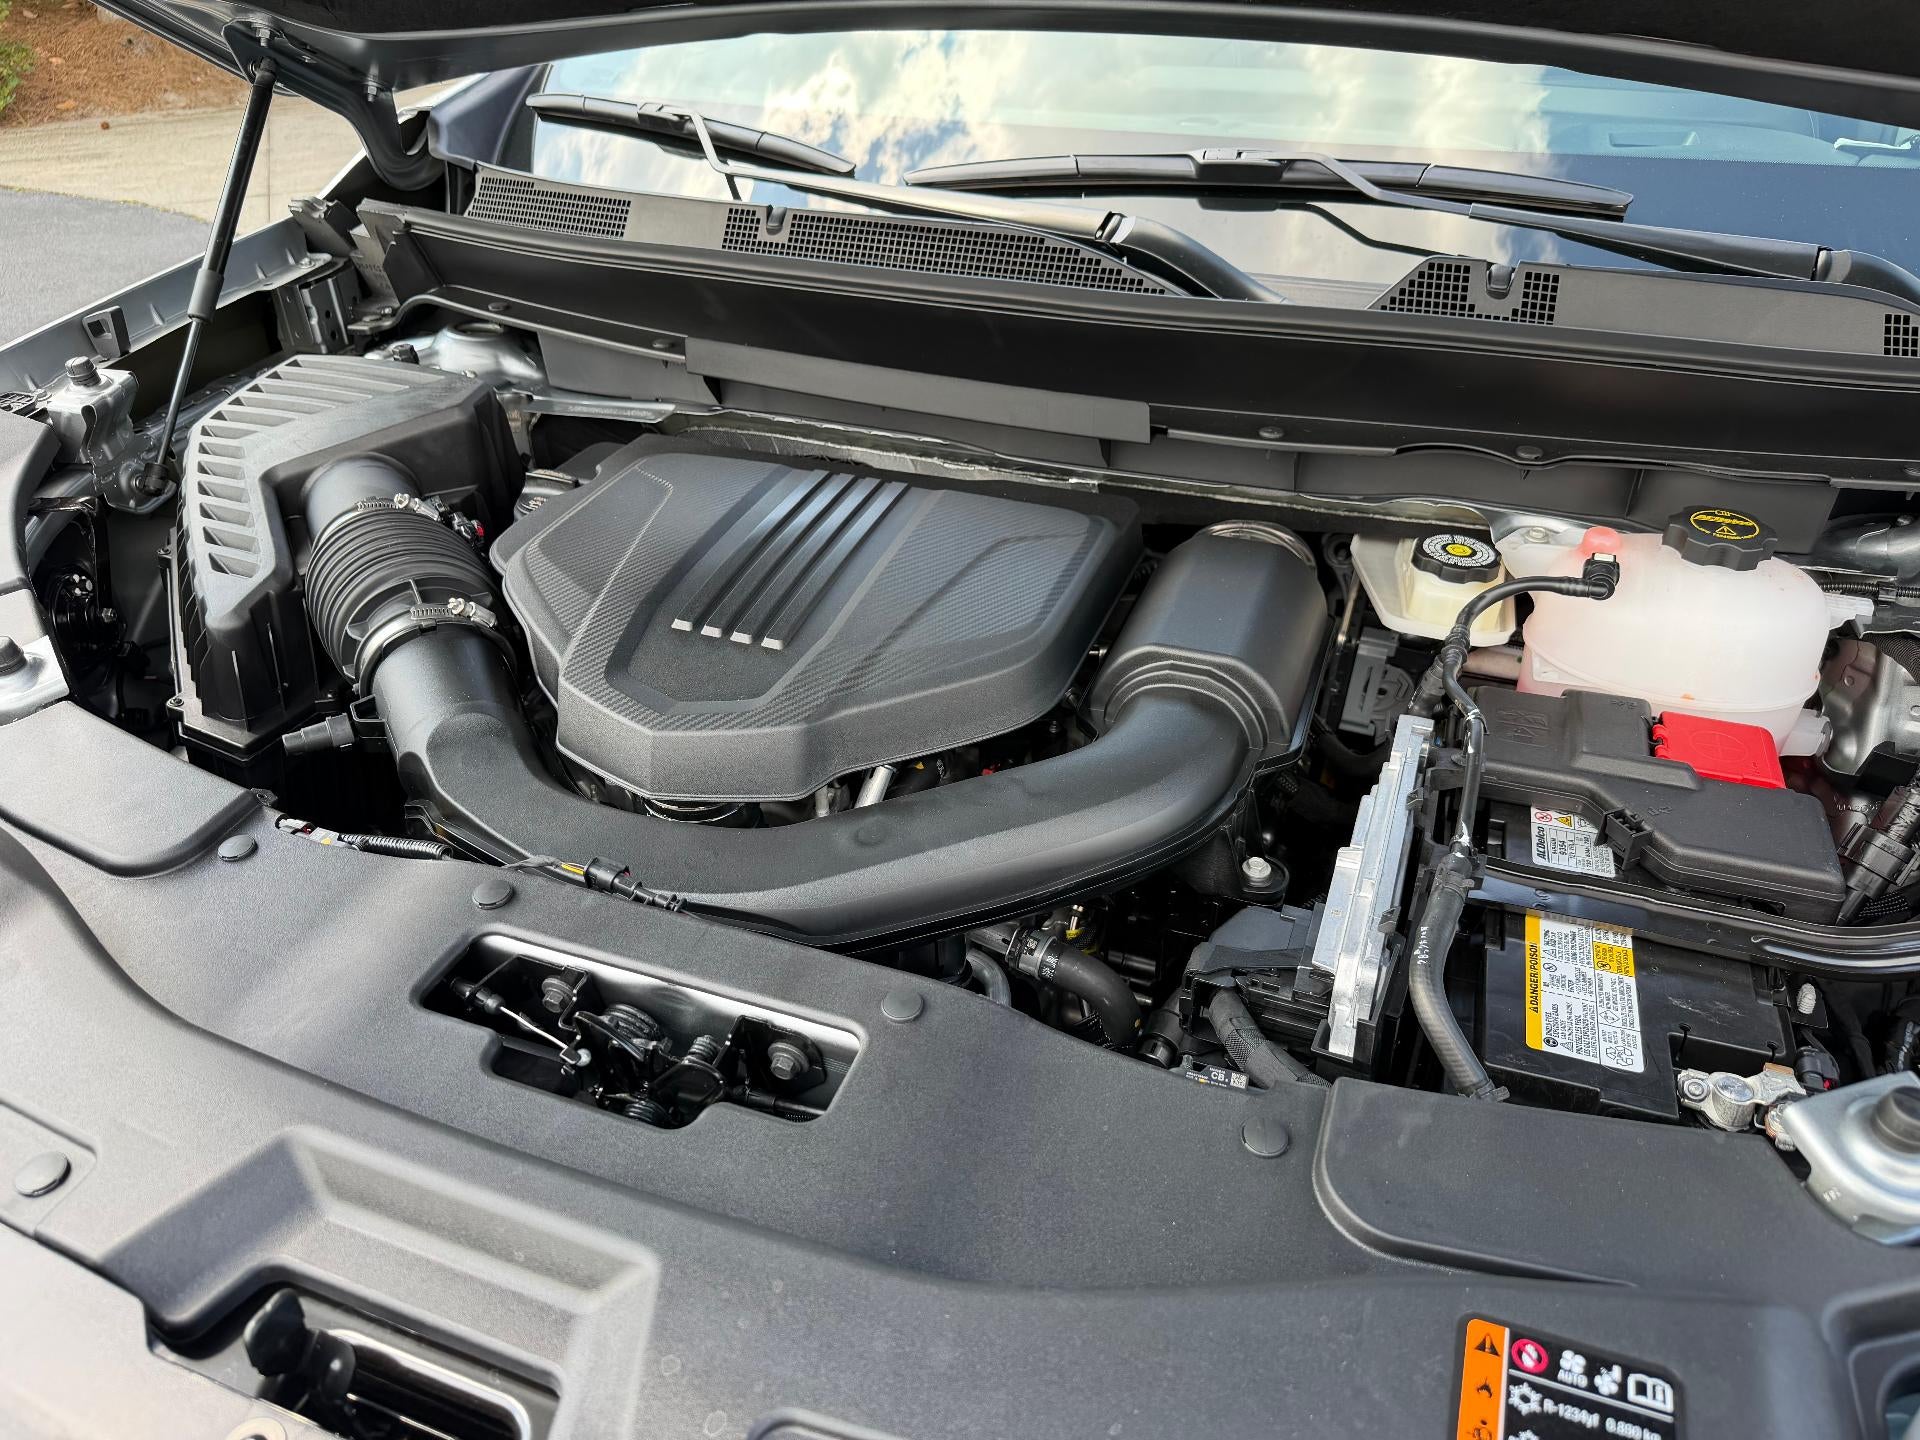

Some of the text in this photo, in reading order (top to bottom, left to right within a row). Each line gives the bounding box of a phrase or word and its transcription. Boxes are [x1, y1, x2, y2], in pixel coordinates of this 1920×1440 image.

[1535, 826, 1547, 861] ACDelco
[1557, 1369, 1588, 1388] AUTO
[1543, 1398, 1600, 1429] R-1234yf
